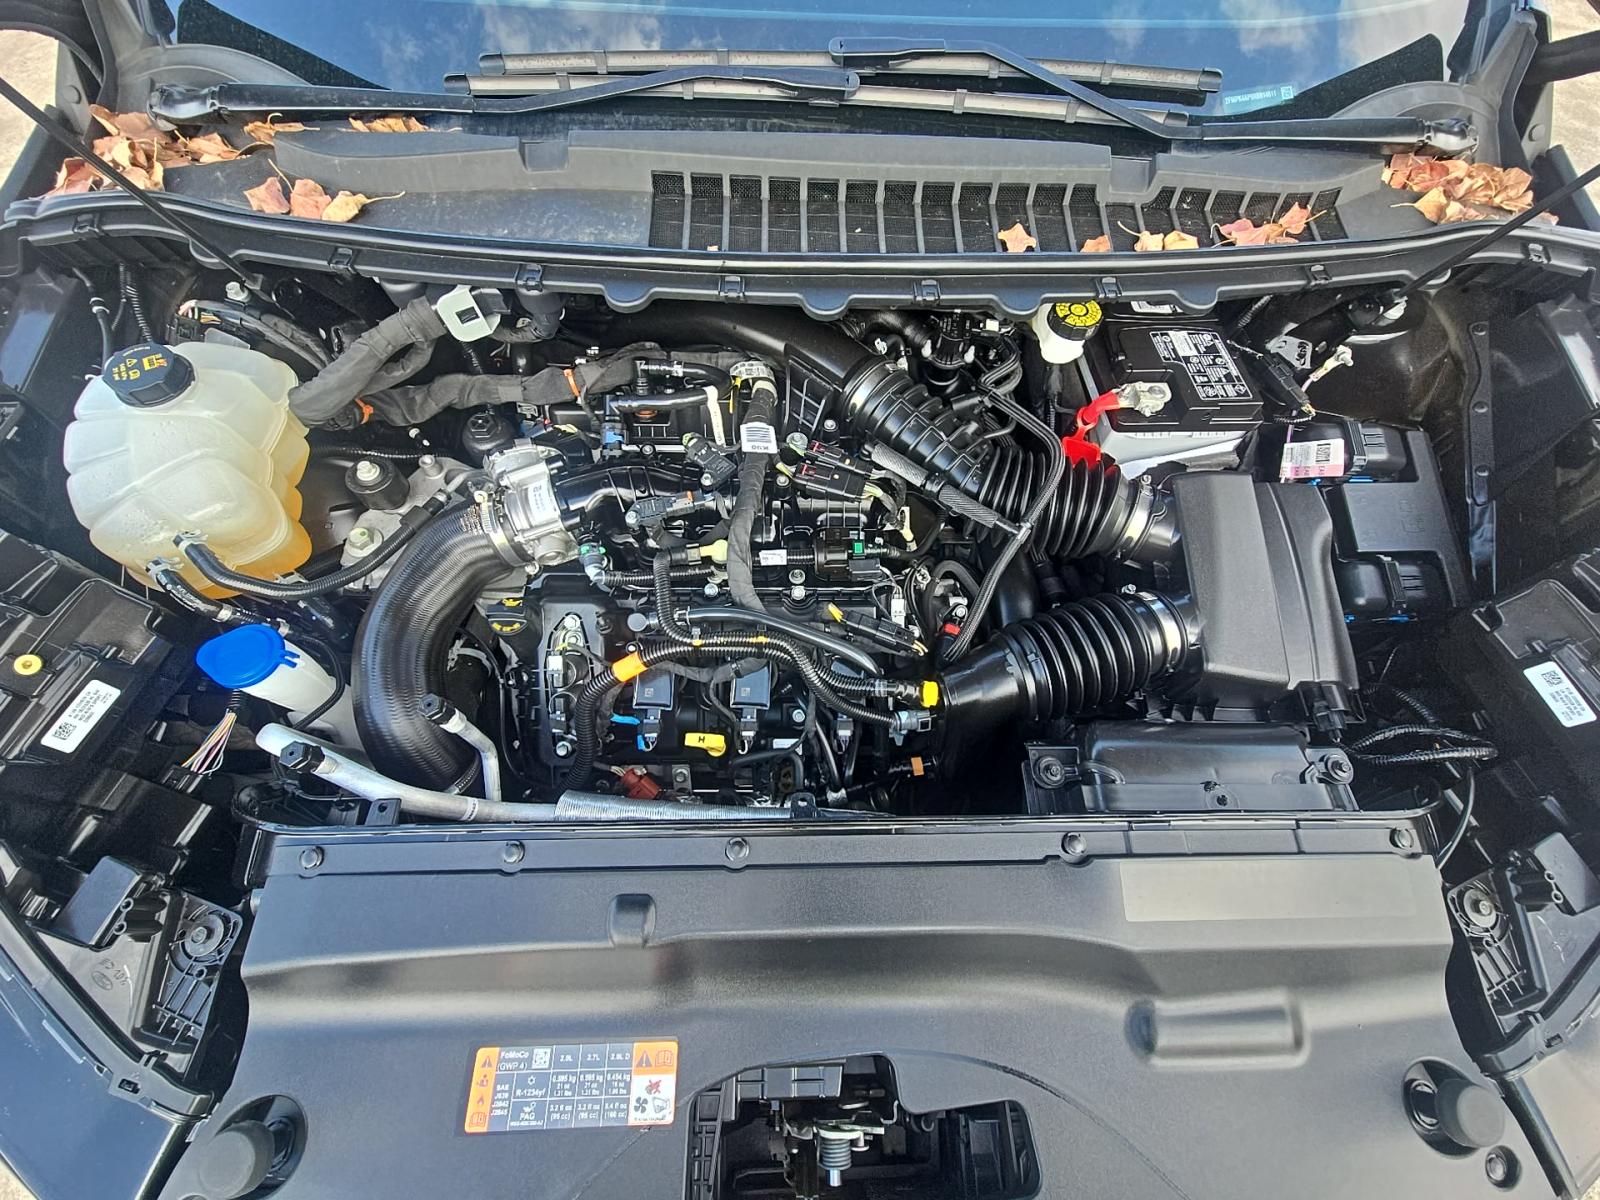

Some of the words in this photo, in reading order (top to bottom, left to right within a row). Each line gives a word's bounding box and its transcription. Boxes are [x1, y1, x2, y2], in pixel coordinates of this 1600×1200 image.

[500, 1051, 529, 1059] FoMoCo
[497, 1062, 518, 1072] (GWP
[519, 1062, 528, 1071] 4)
[515, 1088, 546, 1097] R-1234yf
